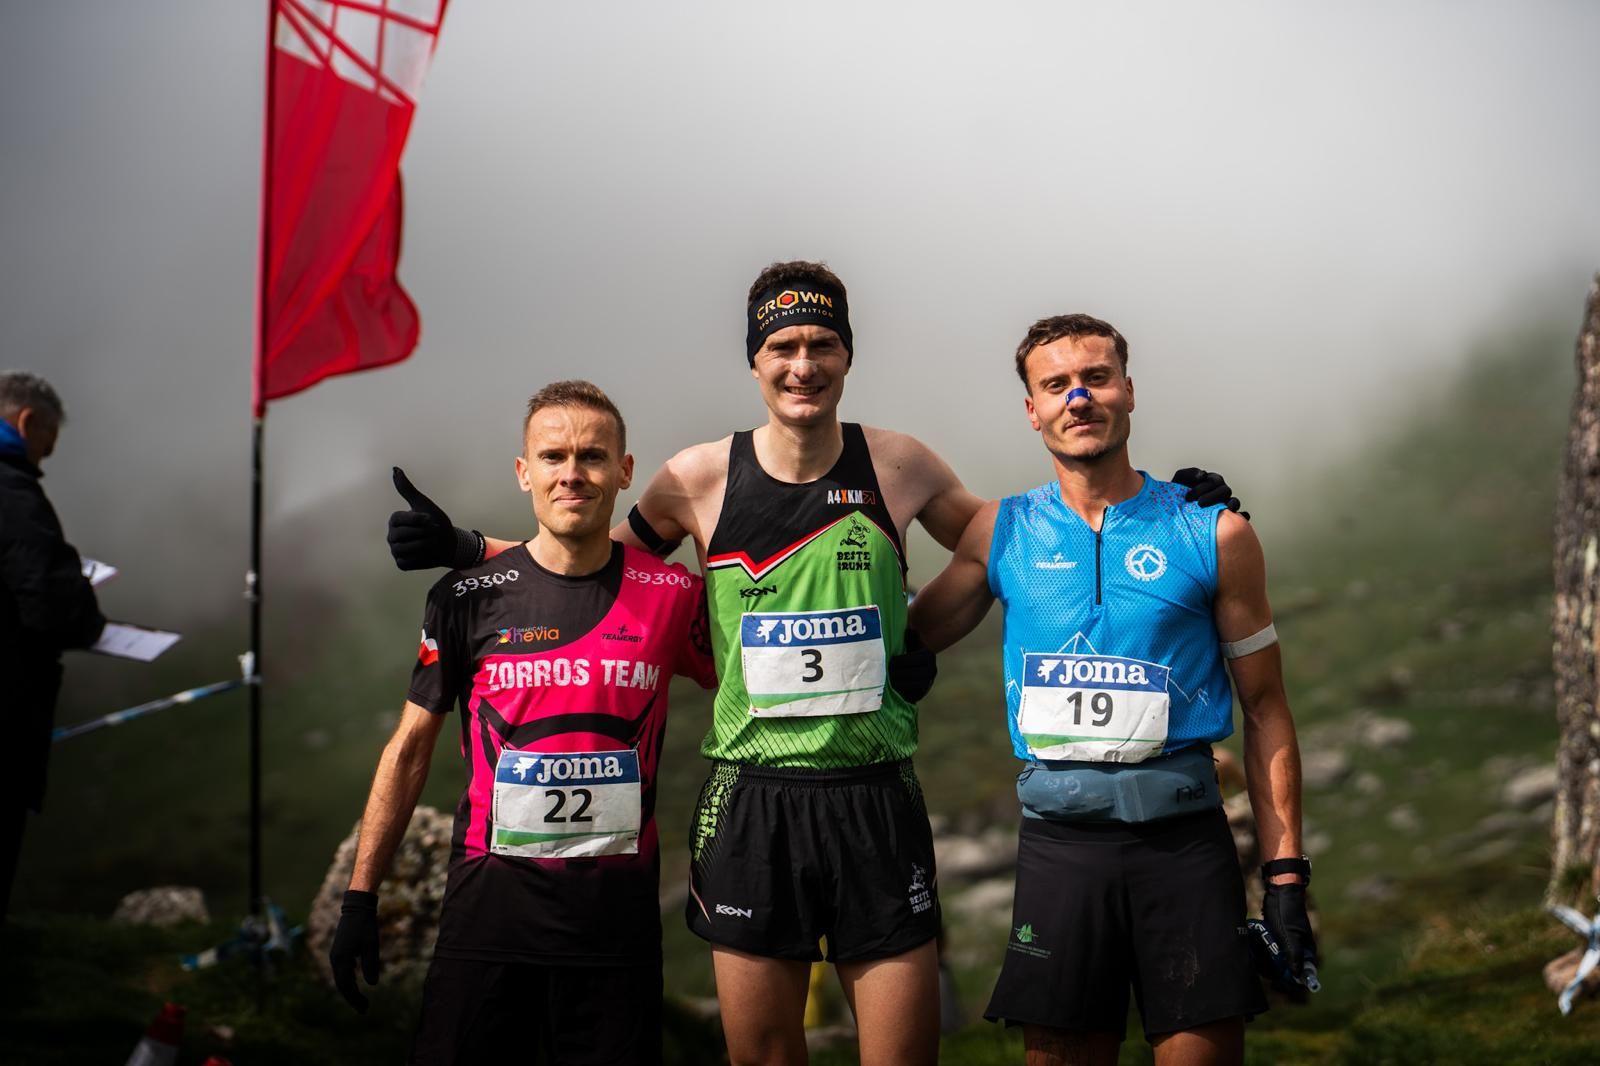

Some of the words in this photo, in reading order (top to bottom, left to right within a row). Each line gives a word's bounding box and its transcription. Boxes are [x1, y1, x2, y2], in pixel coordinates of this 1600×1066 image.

[757, 290, 833, 320] CROWN
[781, 308, 834, 318] NUTRITION
[827, 489, 863, 505] A4XKM
[836, 550, 871, 561] BESTE
[452, 569, 520, 597] 39300
[624, 567, 692, 589] 39300
[513, 627, 560, 643] hevia
[778, 614, 867, 644] Joma
[485, 657, 591, 691] ZORROS
[600, 658, 661, 691] TEAM
[801, 649, 824, 682] 3
[1059, 658, 1150, 685] Joma
[1066, 691, 1114, 727] 19
[536, 756, 623, 784] Joma
[543, 788, 593, 823] 22
